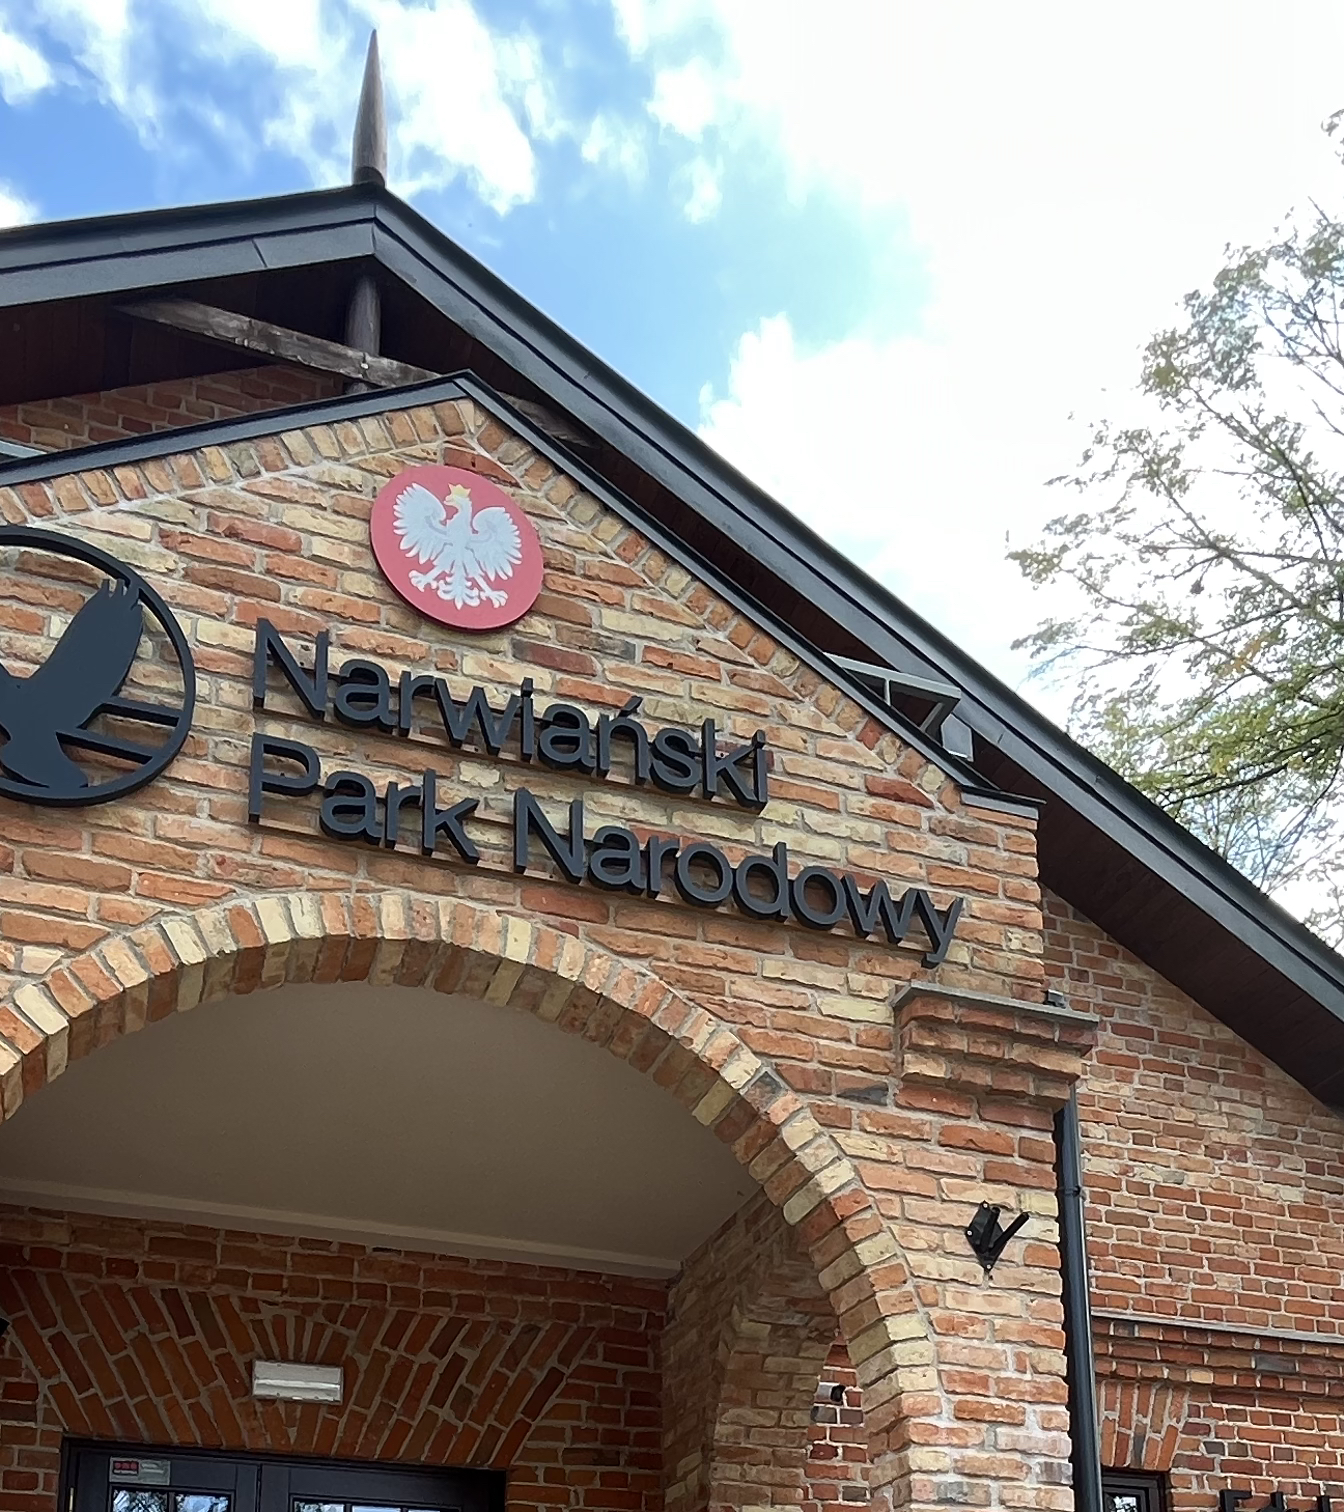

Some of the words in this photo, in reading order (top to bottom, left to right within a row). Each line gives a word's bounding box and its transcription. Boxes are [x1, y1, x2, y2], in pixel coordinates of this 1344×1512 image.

[253, 617, 768, 812] Narwiański
[249, 732, 480, 863] Park
[513, 785, 966, 968] Narodowy
